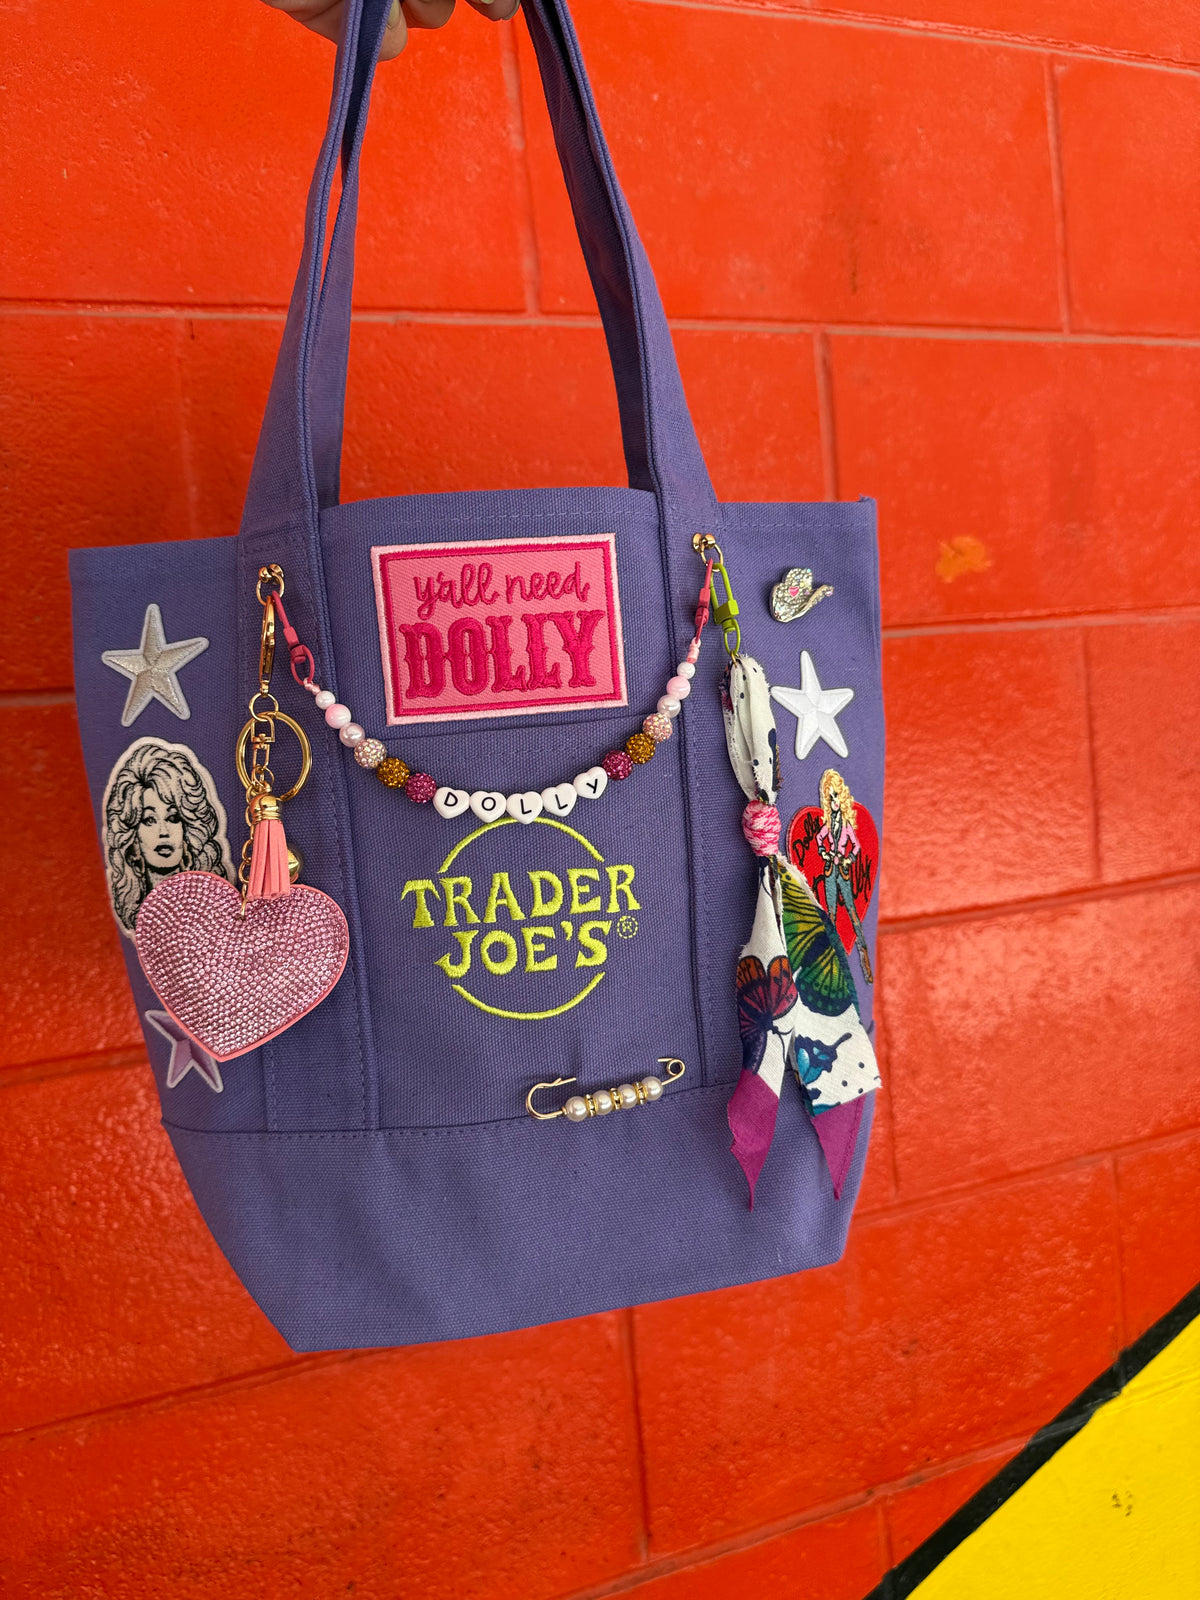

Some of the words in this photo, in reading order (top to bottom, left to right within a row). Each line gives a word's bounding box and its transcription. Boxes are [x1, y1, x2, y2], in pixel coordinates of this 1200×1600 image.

[505, 561, 591, 605] need
[399, 609, 605, 699] DOLLY
[443, 778, 599, 815] DOLLY
[400, 864, 642, 928] TRADER
[434, 920, 612, 979] JOE'S
